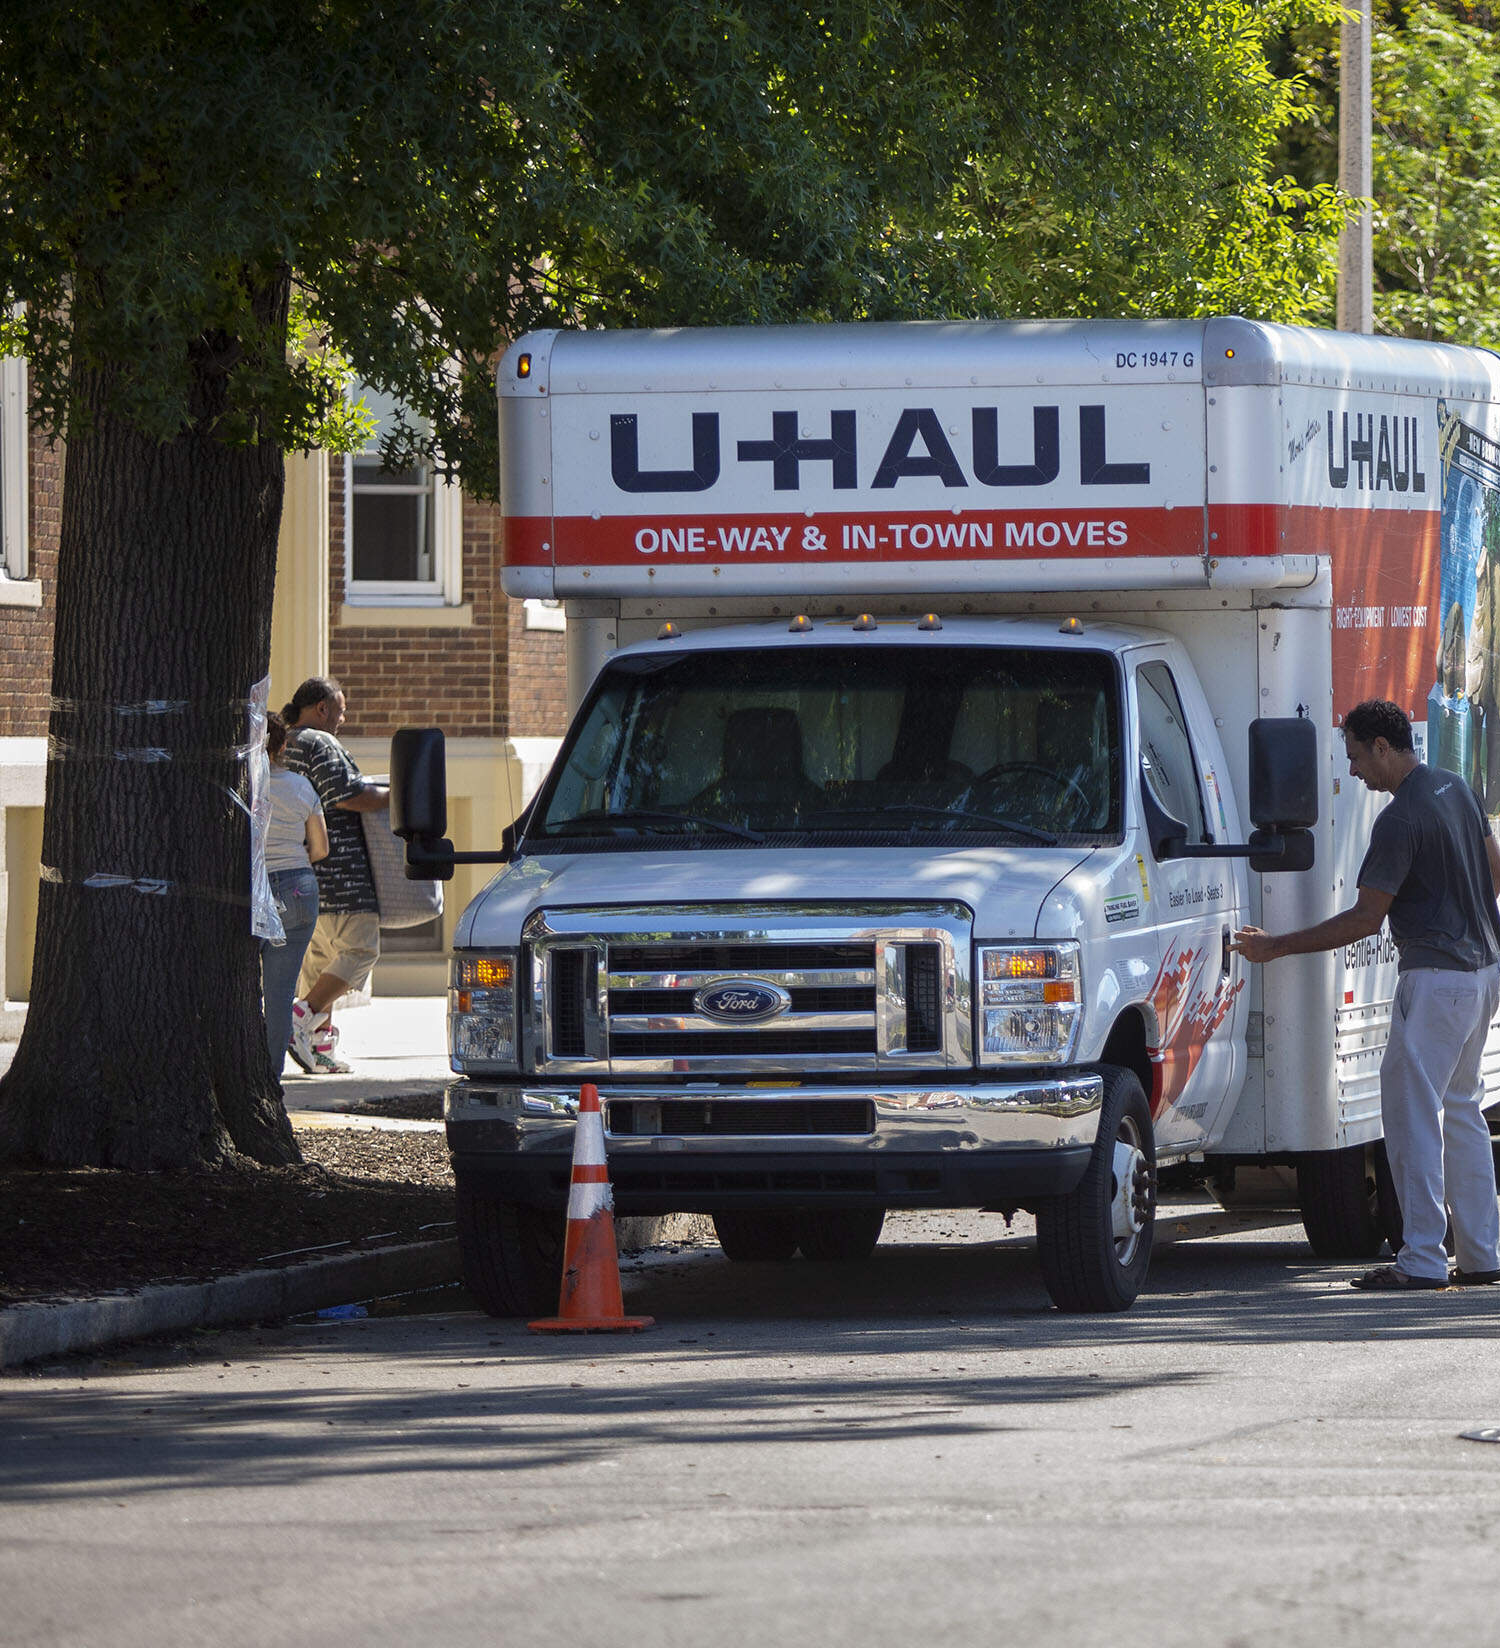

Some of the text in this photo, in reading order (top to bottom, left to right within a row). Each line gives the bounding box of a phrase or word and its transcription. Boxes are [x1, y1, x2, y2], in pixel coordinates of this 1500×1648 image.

[1116, 352, 1194, 368] DC 1947 G
[610, 405, 1150, 493] U-HAUL
[1327, 410, 1425, 492] U-HAUL
[634, 520, 1128, 553] ONE-WAY & IN-TOWN MOVES
[1391, 606, 1412, 627] LOWEST
[1413, 606, 1427, 627] COST
[1169, 890, 1185, 908] Easier
[1192, 887, 1203, 903] Load
[1207, 884, 1219, 900] Seats
[716, 991, 759, 1010] Ford
